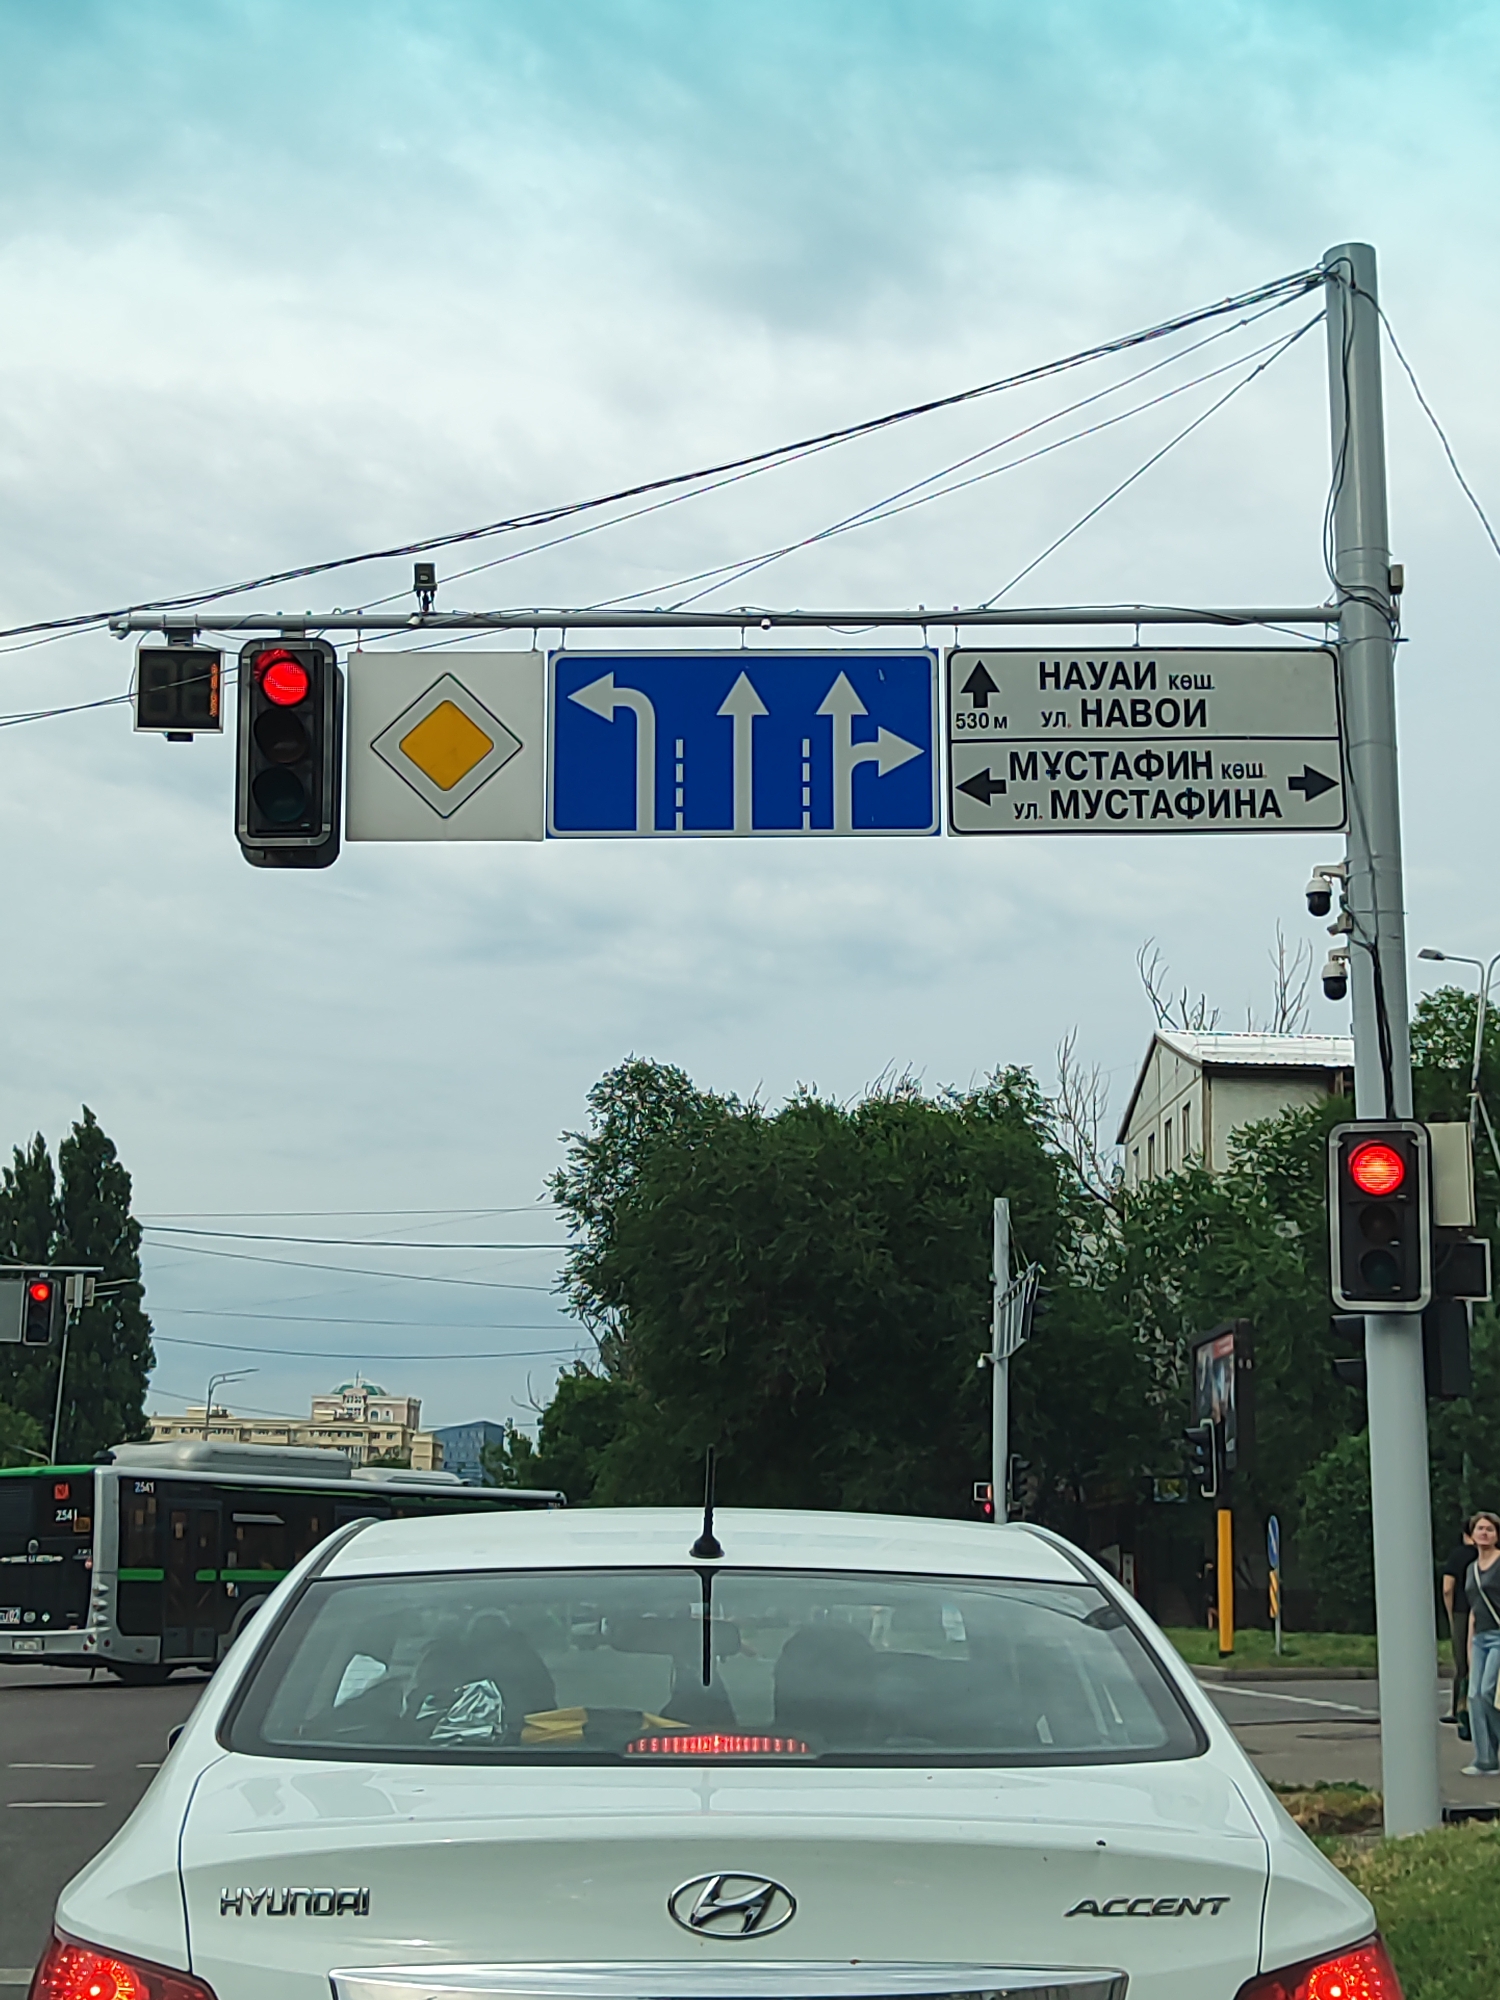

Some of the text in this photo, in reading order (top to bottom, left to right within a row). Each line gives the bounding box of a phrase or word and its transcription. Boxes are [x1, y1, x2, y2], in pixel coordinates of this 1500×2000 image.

[1039, 661, 1157, 691] НАУАИ
[955, 712, 1008, 730] 530 м
[1040, 697, 1207, 729] ул. НАВОИ
[1009, 749, 1214, 782] МҰСТАФИН
[1013, 786, 1283, 821] ул. МУСТАФИНА
[55, 1508, 78, 1522] 2541
[220, 1887, 370, 1916] HYUNDAI
[1063, 1896, 1231, 1917] ACCENT
